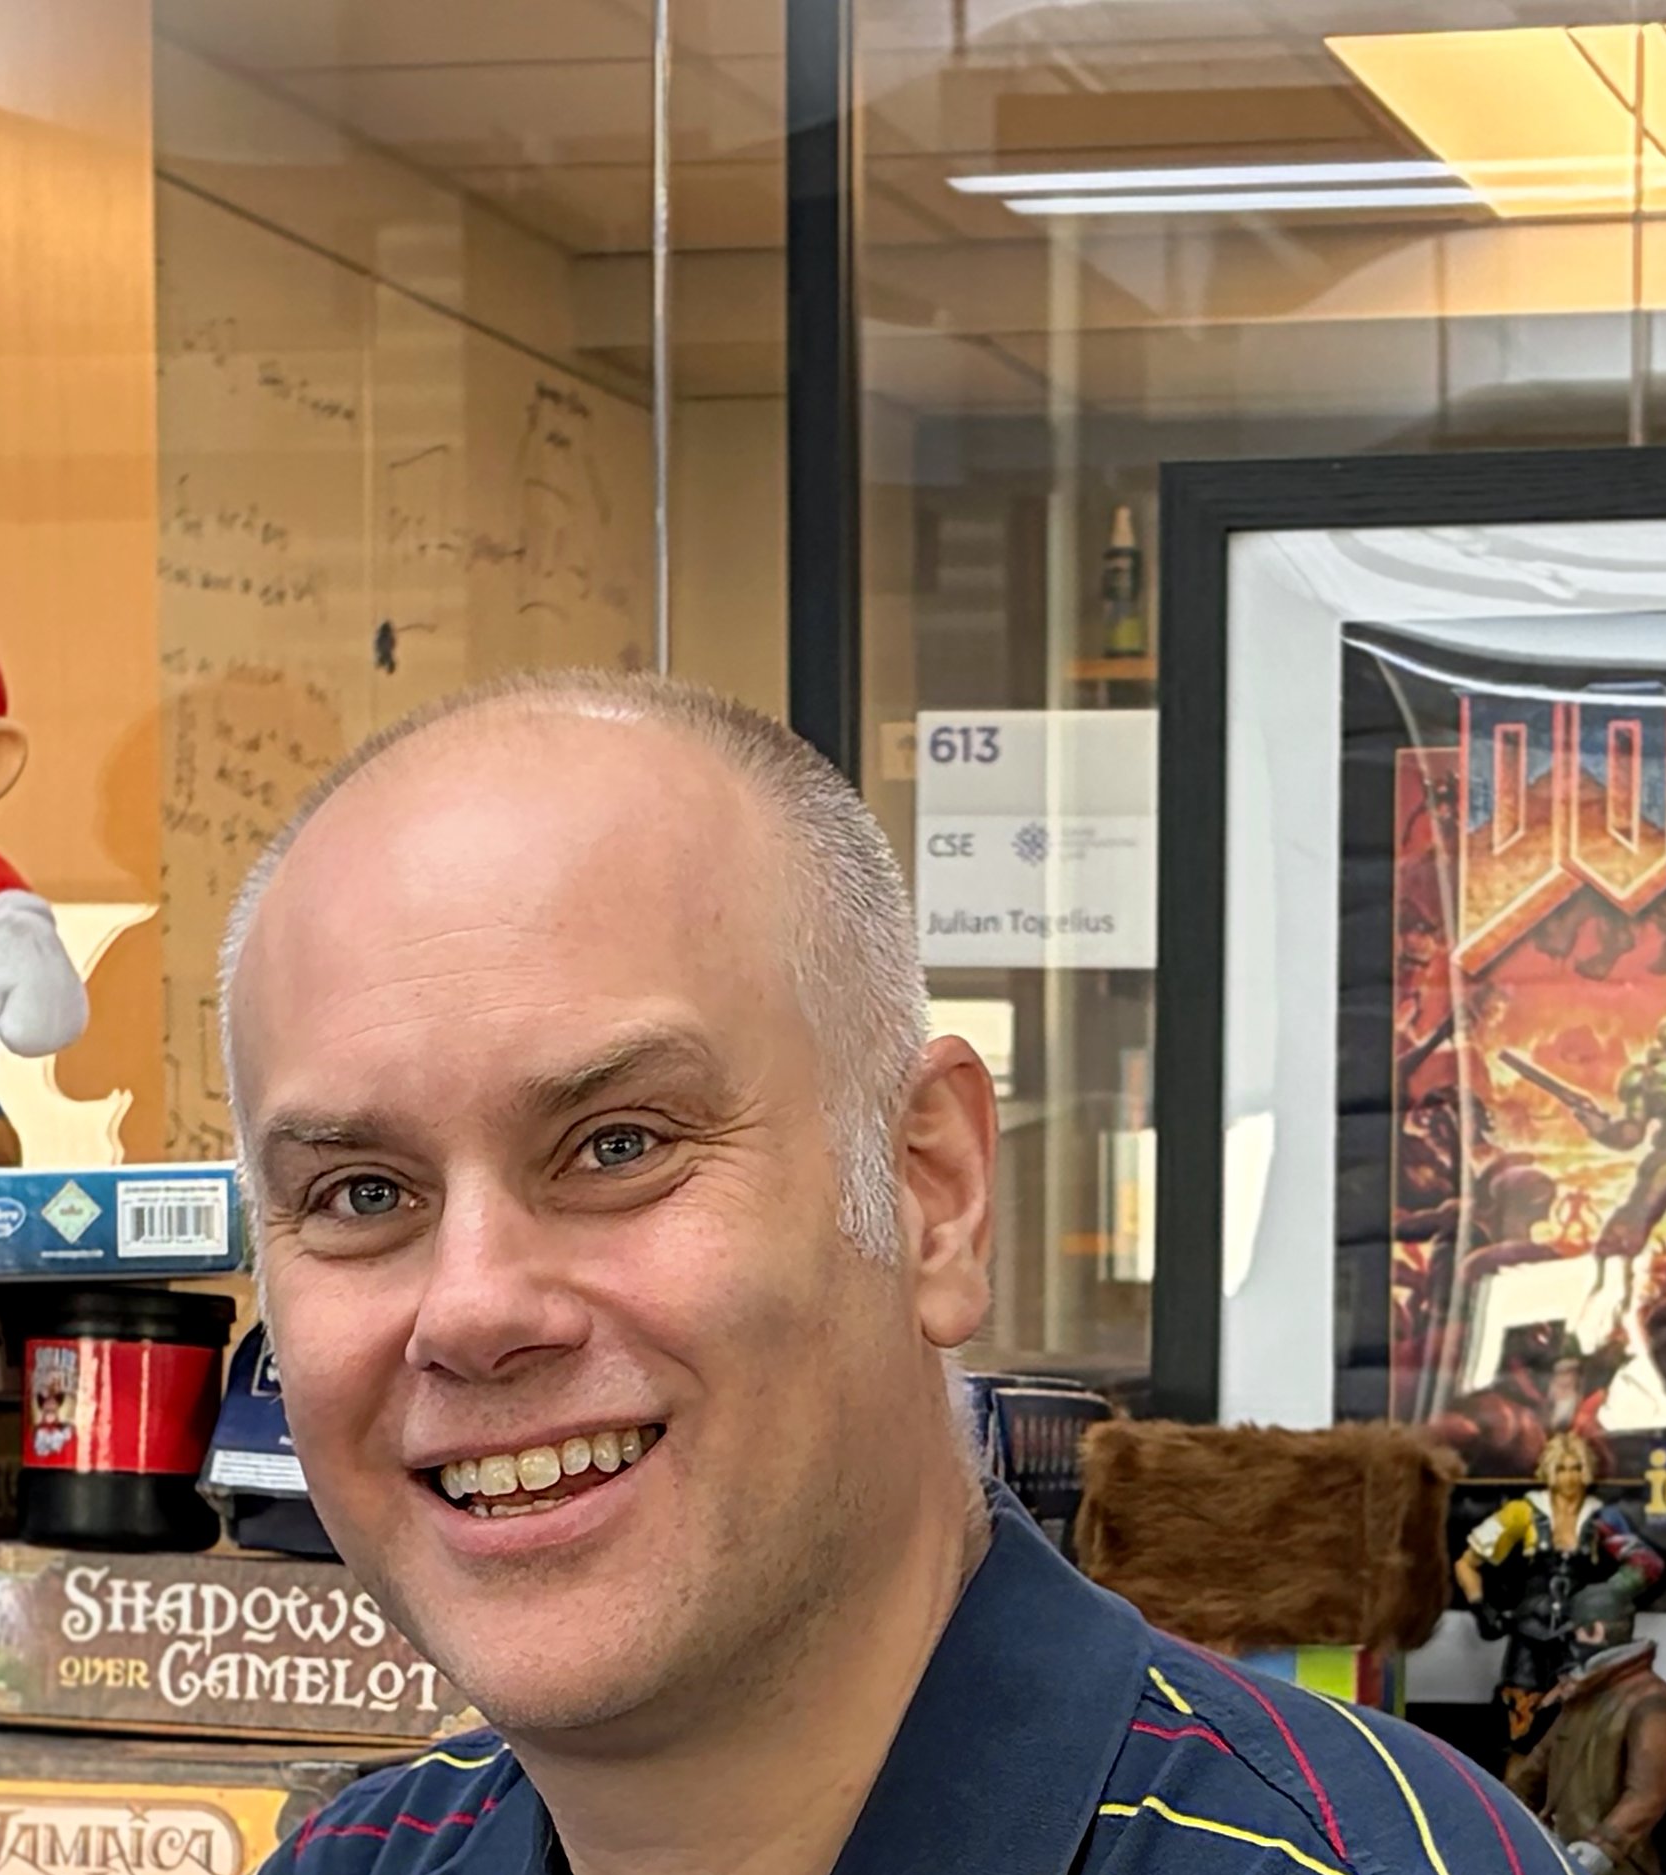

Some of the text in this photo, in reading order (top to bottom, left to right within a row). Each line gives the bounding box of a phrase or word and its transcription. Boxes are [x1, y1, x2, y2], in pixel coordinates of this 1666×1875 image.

[929, 726, 1001, 764] 613
[927, 834, 974, 858] CSE
[927, 909, 1115, 940] Julian Togelius
[62, 1565, 385, 1655] SHADOWS
[59, 1658, 151, 1690] OVER
[158, 1640, 440, 1713] CAMELOT
